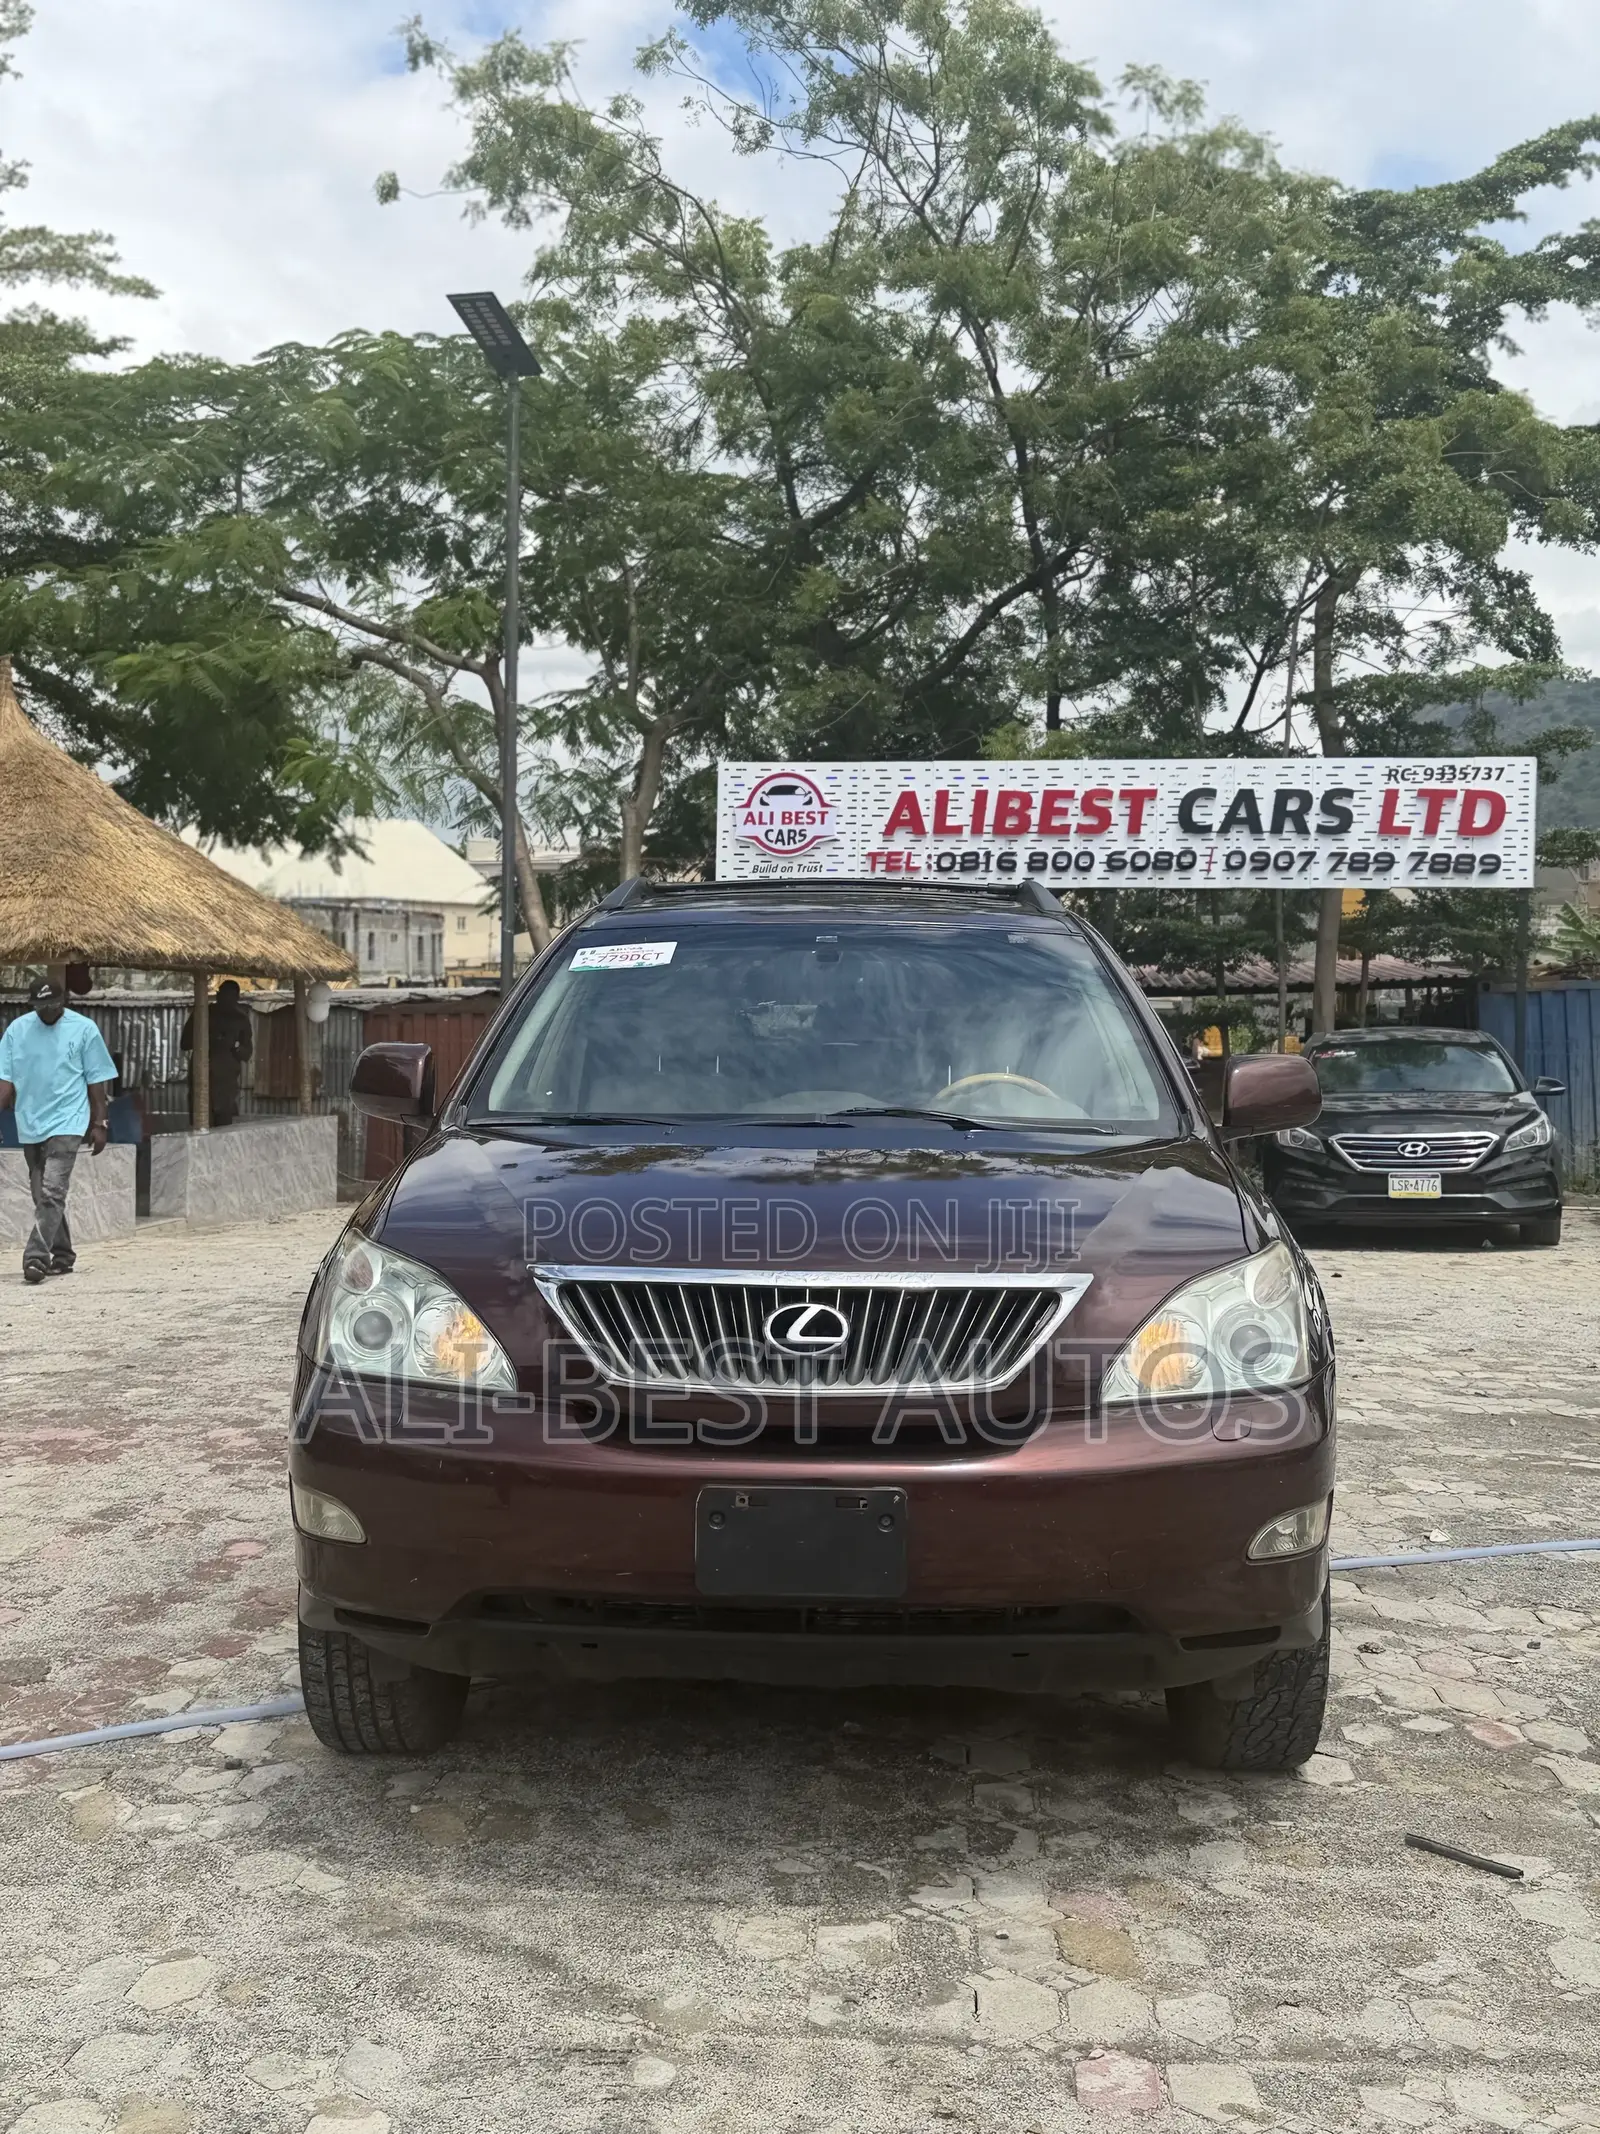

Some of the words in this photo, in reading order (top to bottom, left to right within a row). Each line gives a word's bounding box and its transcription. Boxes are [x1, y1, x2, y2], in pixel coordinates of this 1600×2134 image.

[743, 811, 774, 825] ALI
[781, 811, 829, 825] BEST
[883, 788, 1158, 836] ALIBEST
[1177, 787, 1355, 836] CARS
[1378, 788, 1508, 837] LTD
[764, 828, 808, 846] CARS
[752, 864, 779, 873] Build
[781, 865, 793, 873] on
[797, 863, 823, 873] Trust
[1027, 851, 1095, 873] 800
[1106, 850, 1198, 872] 6080
[1225, 849, 1317, 873] 0907
[1327, 851, 1396, 874] 789
[1408, 851, 1501, 874] 7889
